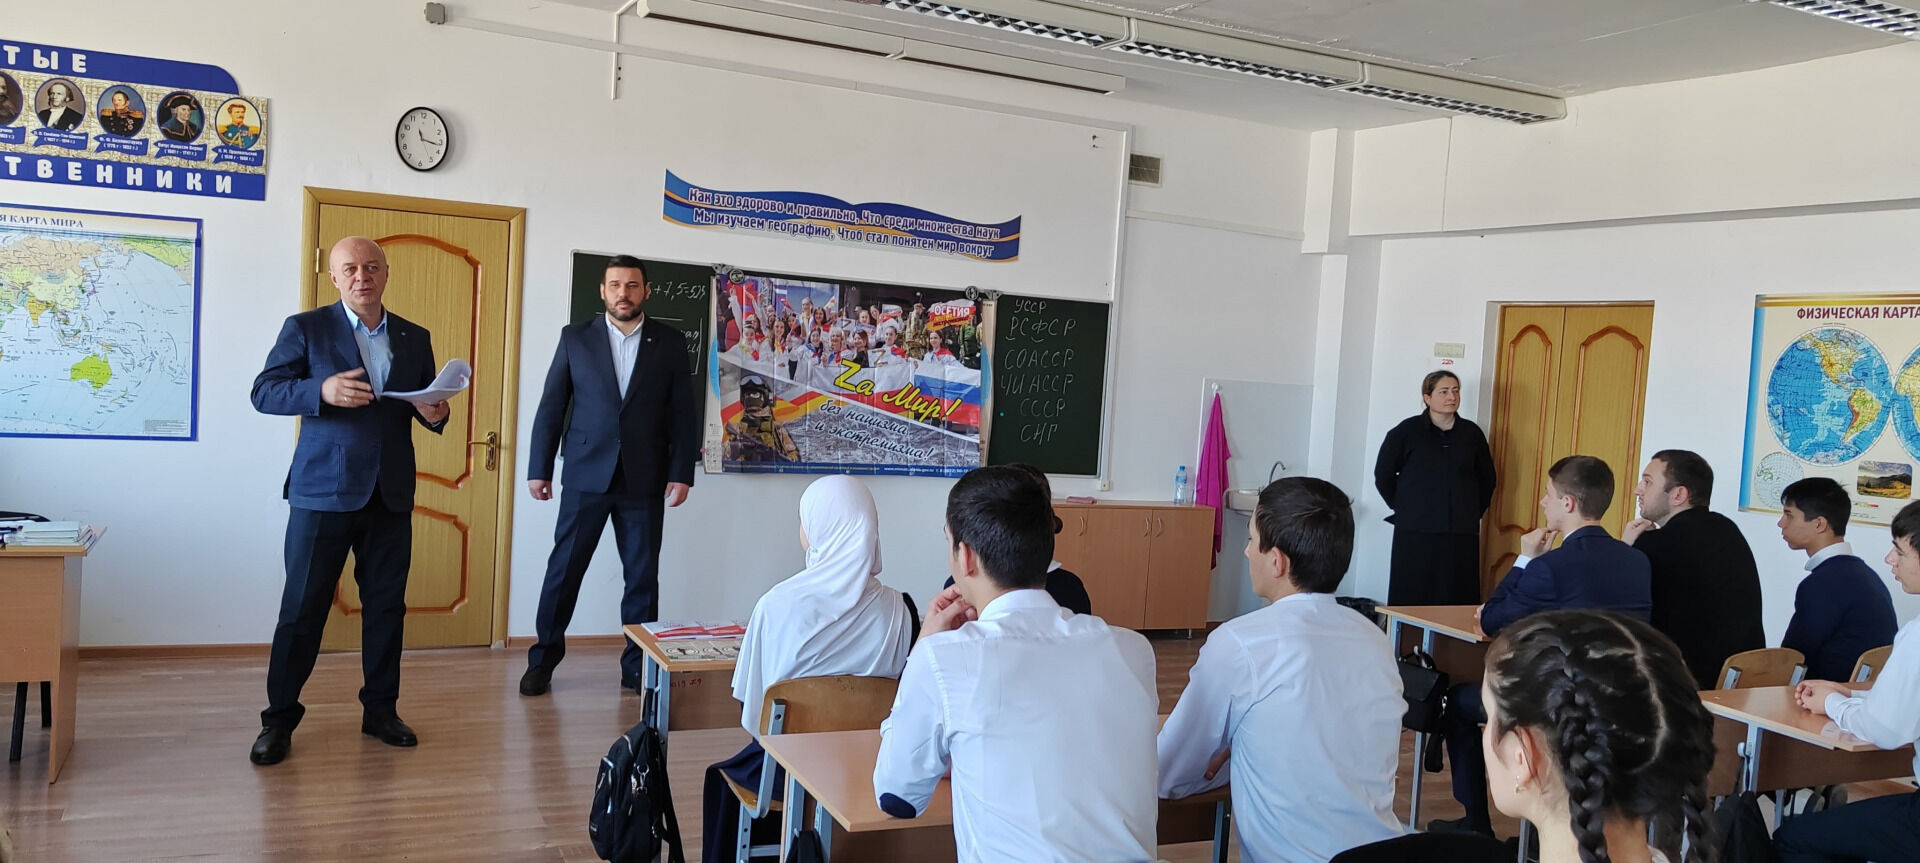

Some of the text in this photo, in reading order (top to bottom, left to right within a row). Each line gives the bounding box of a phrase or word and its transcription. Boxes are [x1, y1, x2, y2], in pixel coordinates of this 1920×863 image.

[3, 45, 87, 73] ТЫЕ
[4, 156, 232, 194] ТВЕННИКИ
[10, 215, 47, 225] КАРТА
[50, 217, 83, 228] МИРА
[689, 189, 1001, 242] Как это здорово и правильно, Что среди множества наук
[694, 209, 994, 257] Мы изучаем географию, Чтоб стал понятен мир вокруг
[934, 305, 970, 318] ОСЕТИЯ
[1014, 299, 1047, 314] УССР
[1797, 307, 1879, 319] ФИЗИЧЕСКАЯ
[1009, 316, 1076, 337] РСФСР
[1004, 348, 1074, 370] СОАССР
[882, 383, 962, 422] Мир!
[1020, 398, 1066, 418] СССР
[820, 399, 908, 435] без нацизма
[815, 421, 934, 460] и экстремизма!
